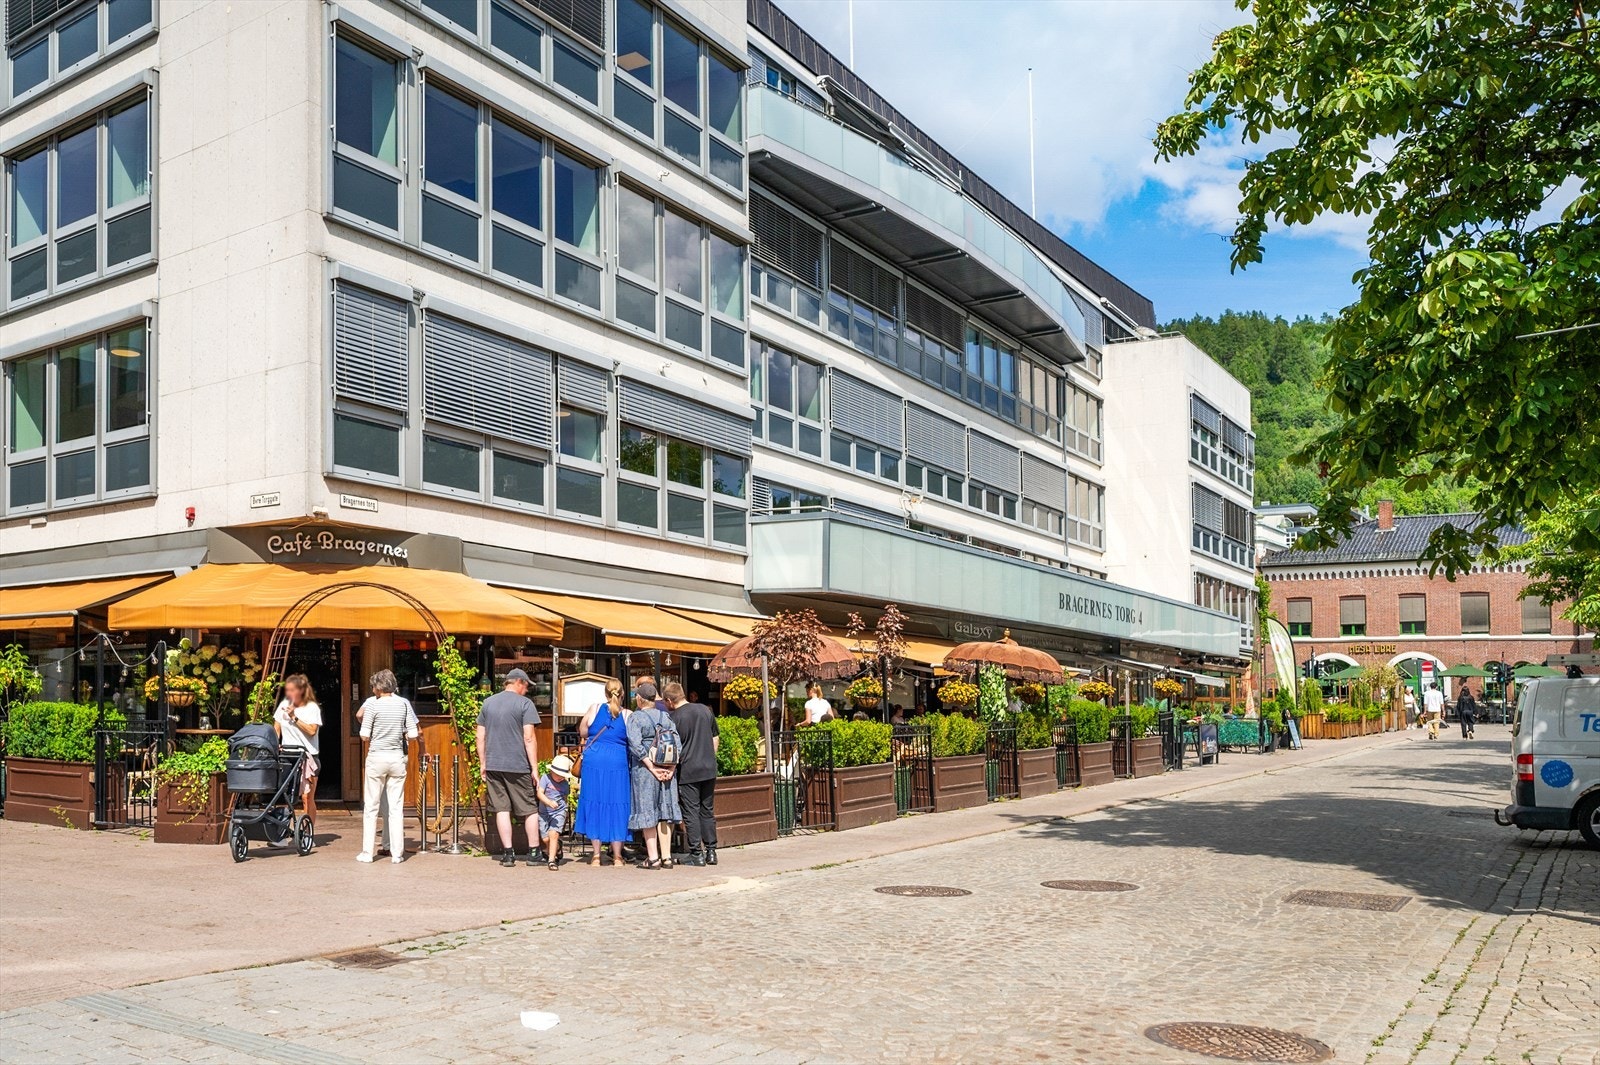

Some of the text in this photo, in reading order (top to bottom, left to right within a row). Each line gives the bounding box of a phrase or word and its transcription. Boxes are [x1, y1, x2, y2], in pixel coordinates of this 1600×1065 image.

[343, 495, 376, 510] Bragernes torg
[267, 531, 409, 559] Café Bragernes
[1059, 592, 1143, 626] BRAGERNES TORG 4
[954, 621, 993, 640] Galaxy
[1580, 714, 1600, 732] Te
